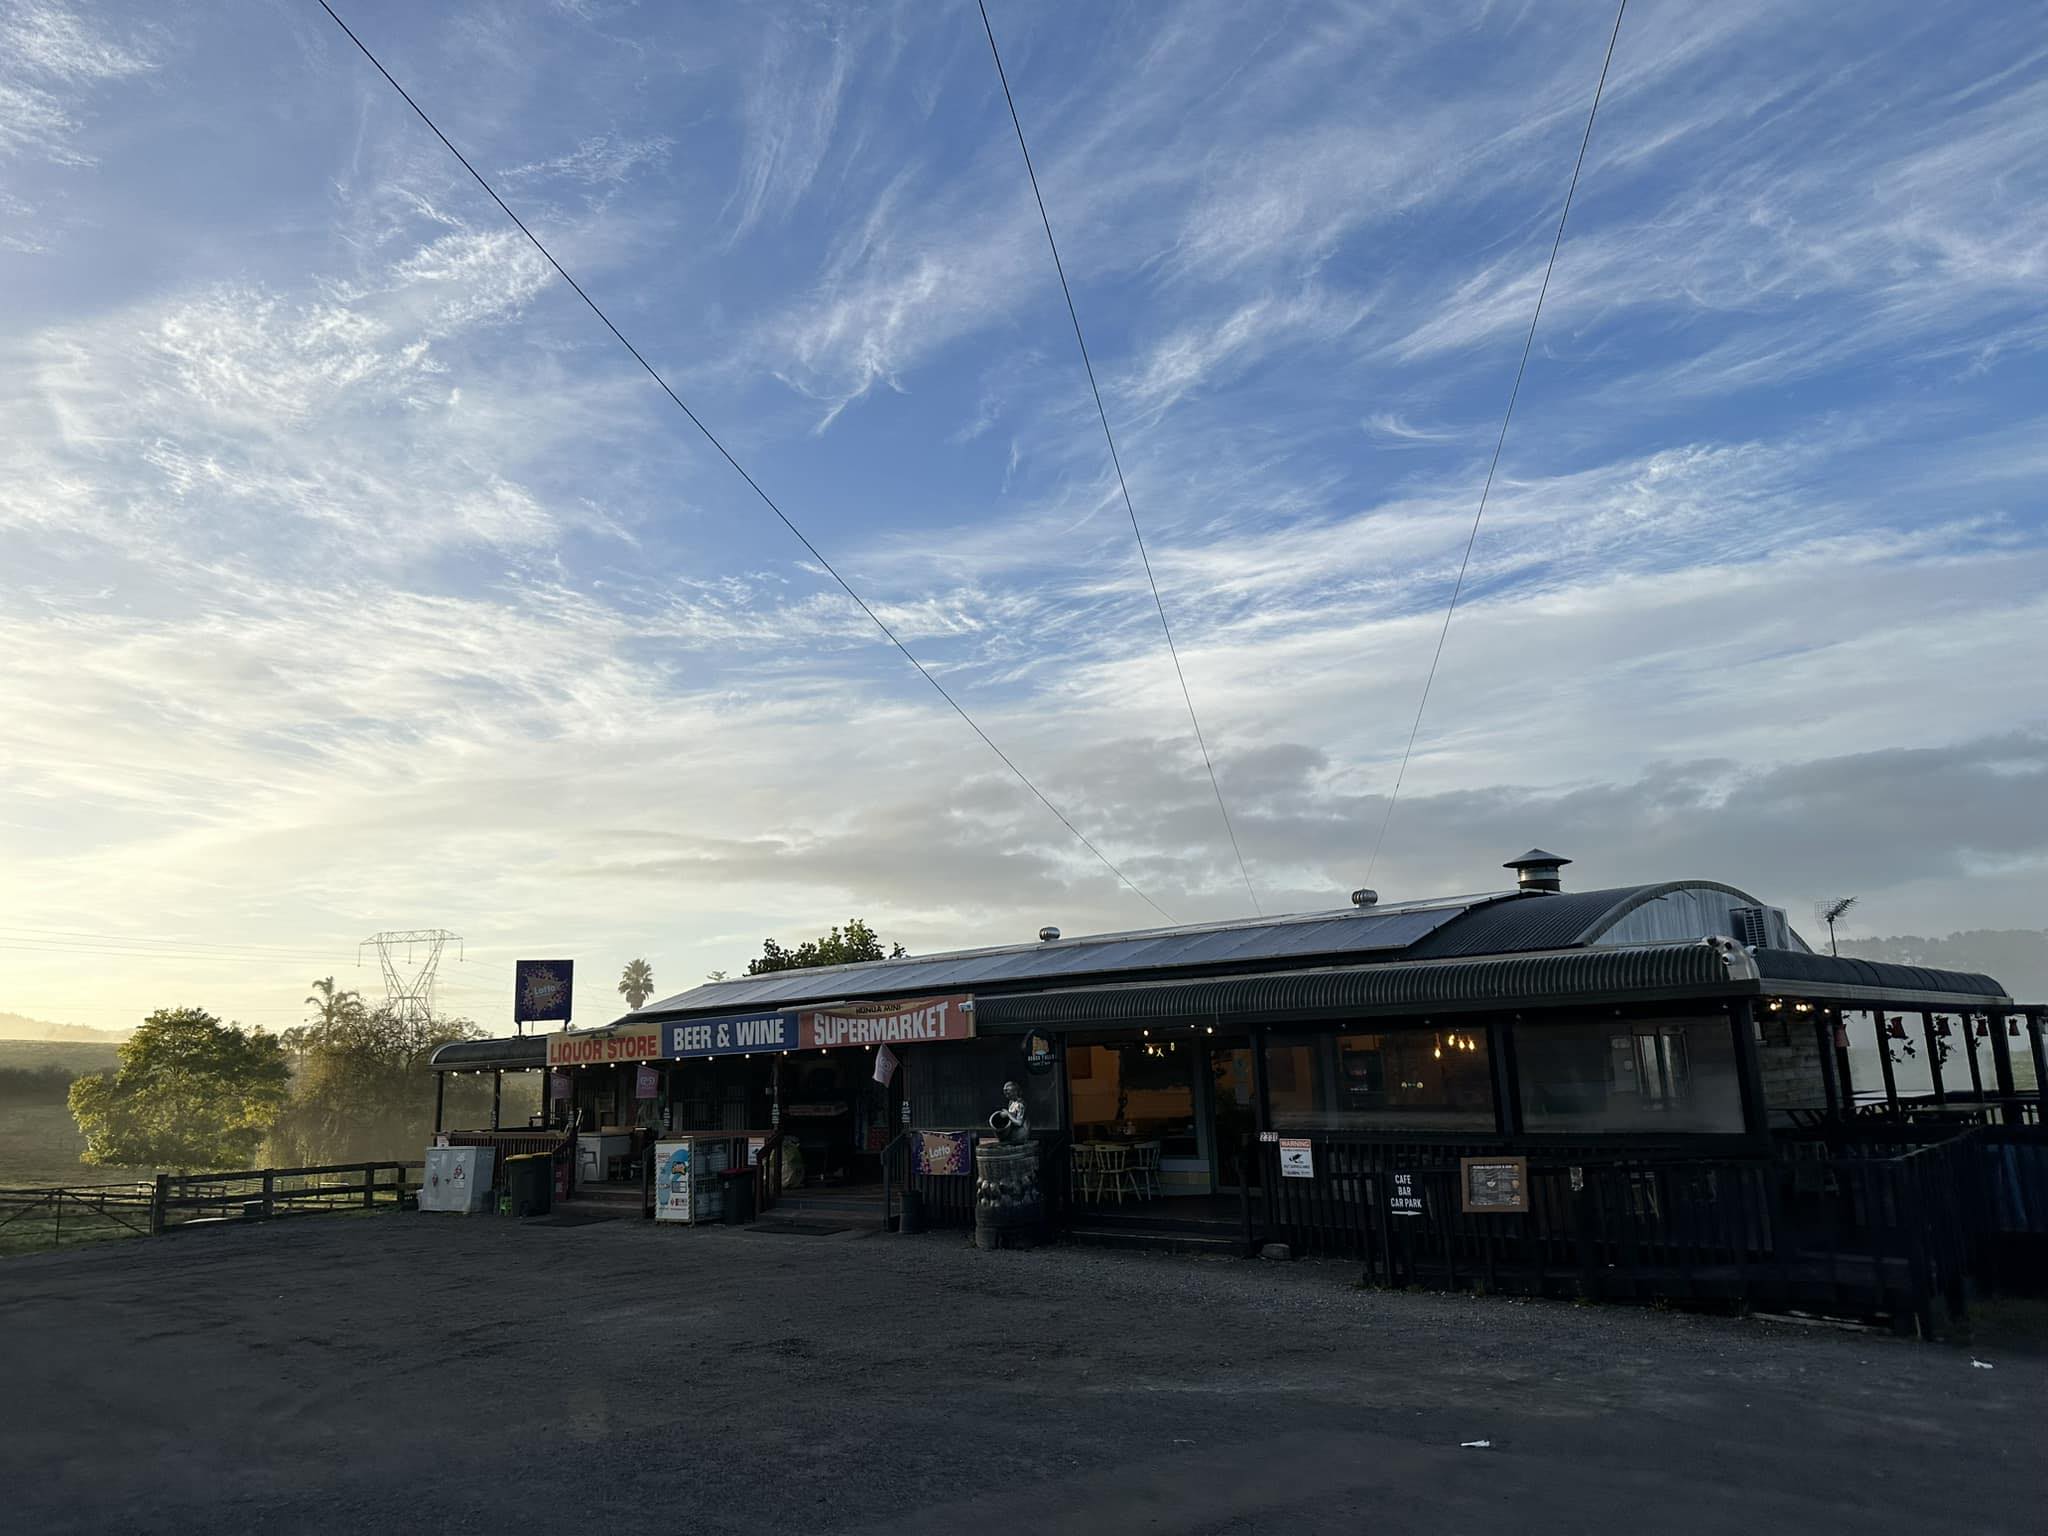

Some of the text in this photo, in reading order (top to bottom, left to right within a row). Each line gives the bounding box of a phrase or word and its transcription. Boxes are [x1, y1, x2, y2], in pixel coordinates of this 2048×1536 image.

[534, 984, 556, 995] Lotto
[814, 1001, 948, 1045] SUPERMARKET
[673, 1018, 784, 1051] BEER & WINE
[550, 1035, 657, 1064] LIQUOR STORE
[929, 1145, 951, 1158] Lotto
[1394, 1174, 1412, 1184] CAFE
[1397, 1186, 1412, 1196] BAR
[1390, 1197, 1422, 1208] CAR PARK
